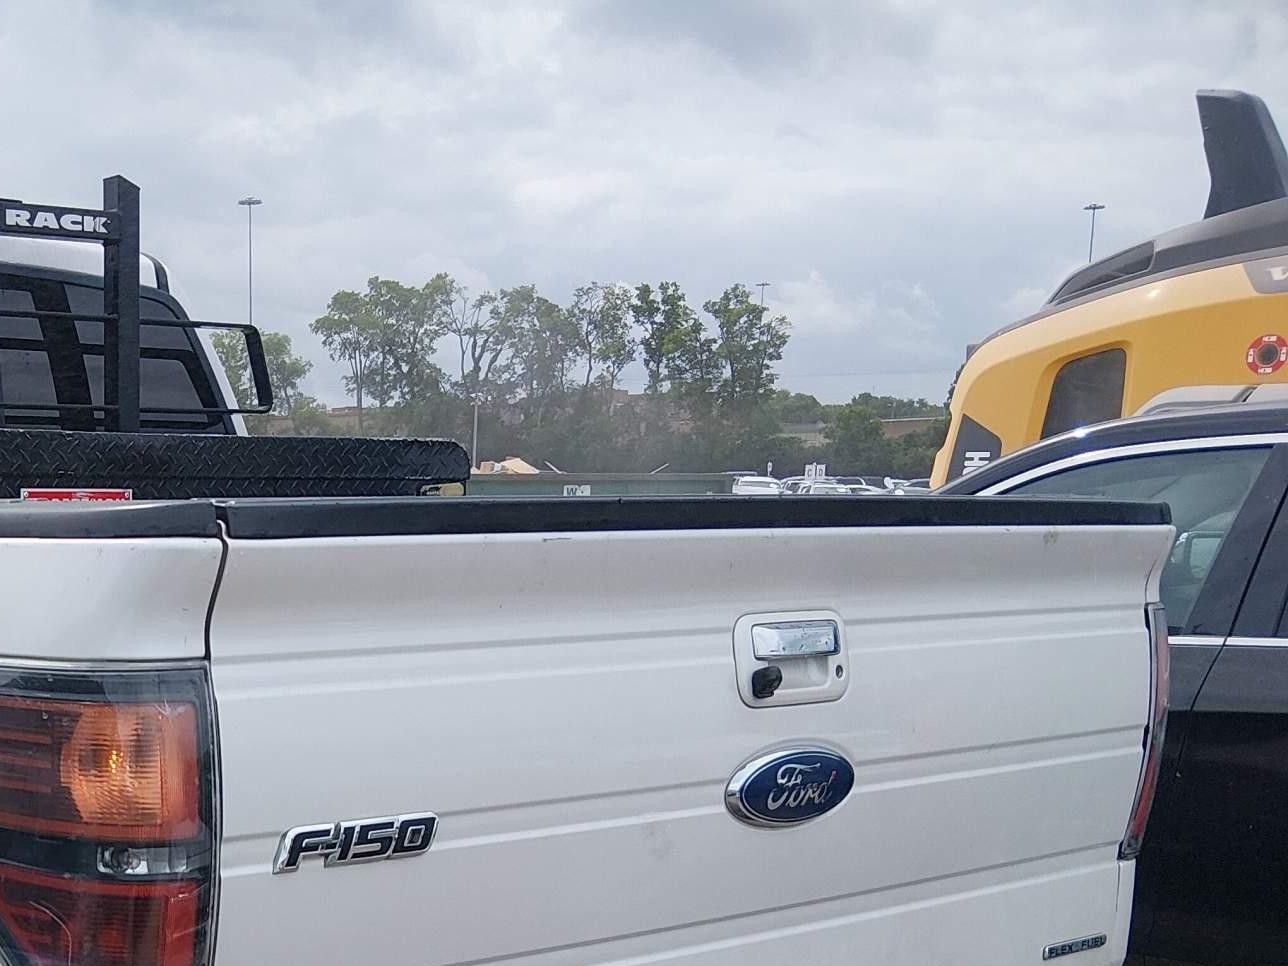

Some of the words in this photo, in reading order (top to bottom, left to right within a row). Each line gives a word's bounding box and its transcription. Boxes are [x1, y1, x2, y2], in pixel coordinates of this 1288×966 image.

[5, 209, 109, 234] RACK
[767, 762, 838, 811] Ford
[272, 811, 440, 875] F-150
